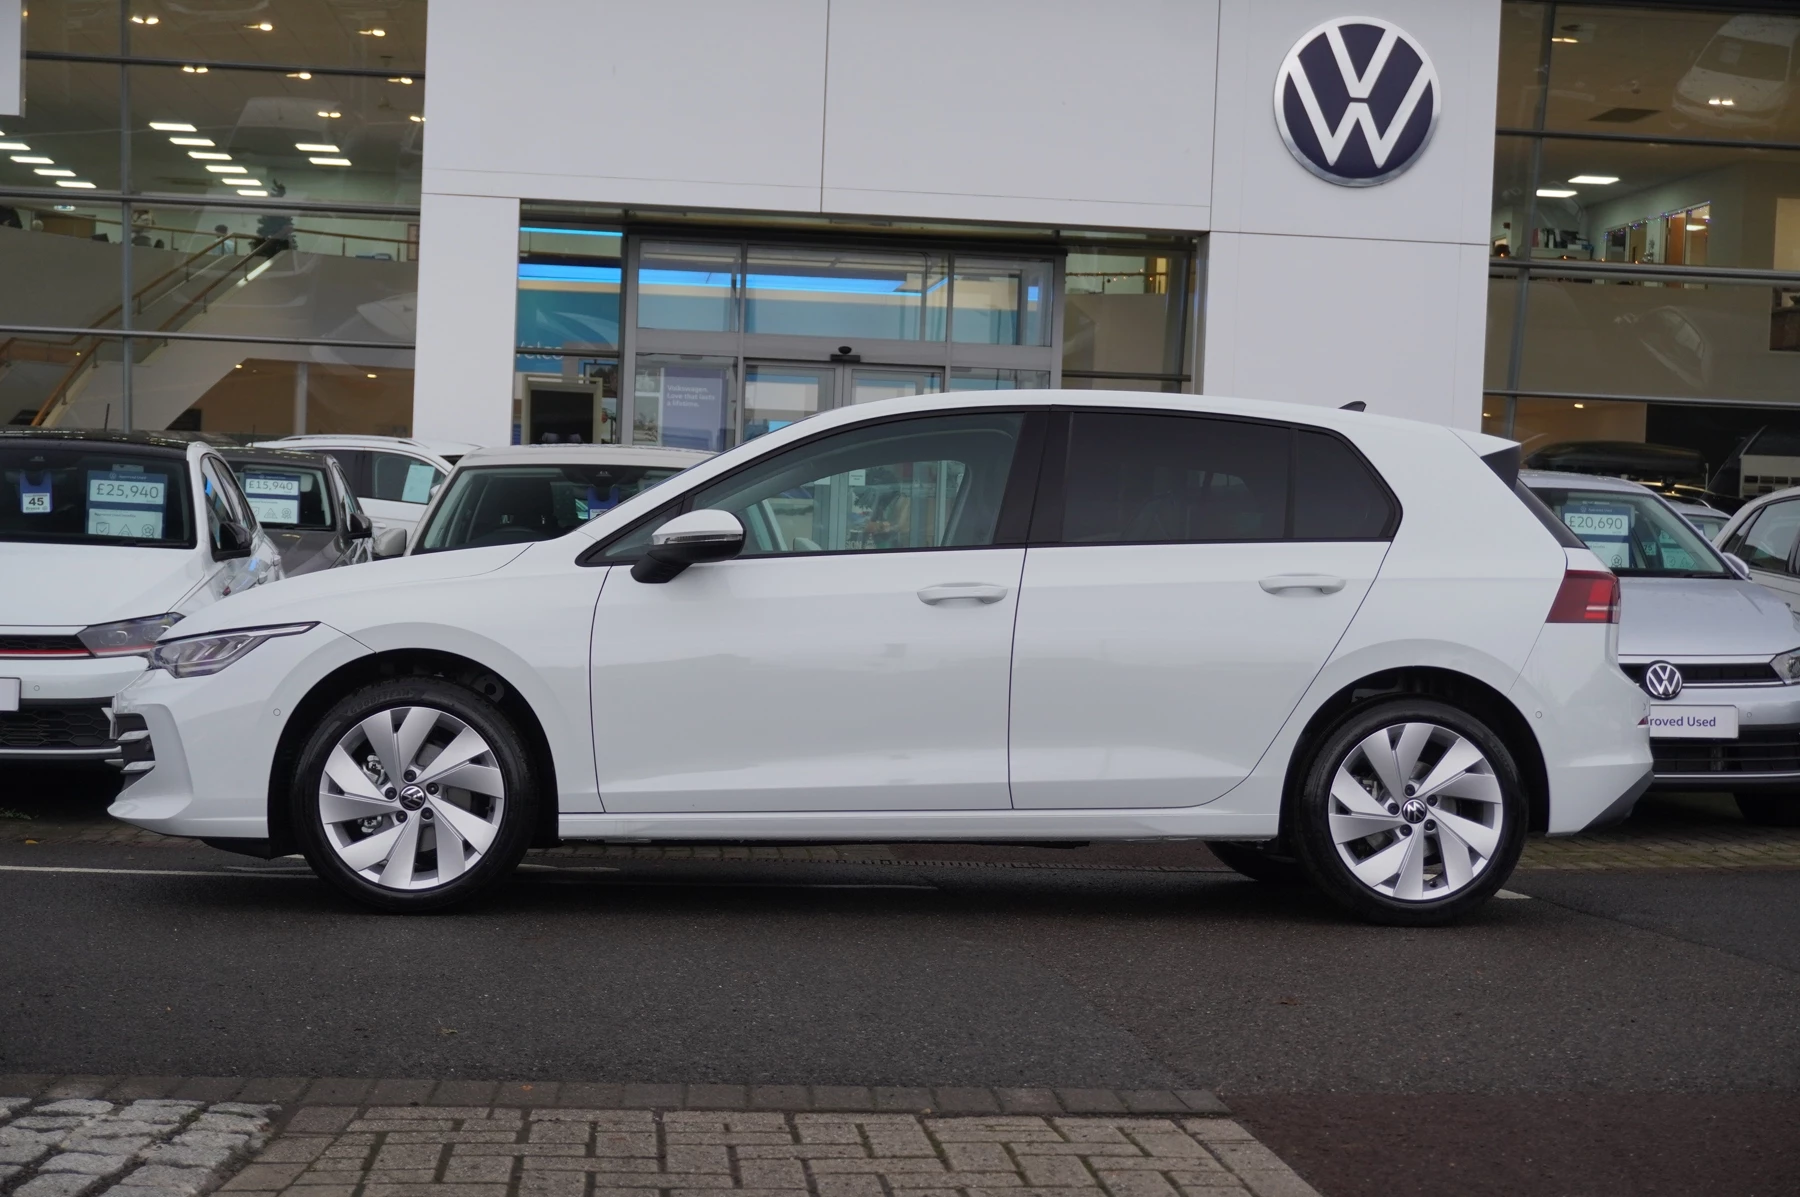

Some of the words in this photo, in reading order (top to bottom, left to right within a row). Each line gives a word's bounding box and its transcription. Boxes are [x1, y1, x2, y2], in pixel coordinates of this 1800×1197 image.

[1281, 20, 1437, 172] VW
[699, 393, 715, 401] lasts
[96, 482, 159, 499] £25,940
[248, 480, 293, 491] £15,940
[28, 497, 44, 506] 45
[1568, 515, 1623, 530] £20,690
[1647, 664, 1681, 696] VW
[1649, 716, 1684, 727] roved
[1687, 716, 1716, 727] Used
